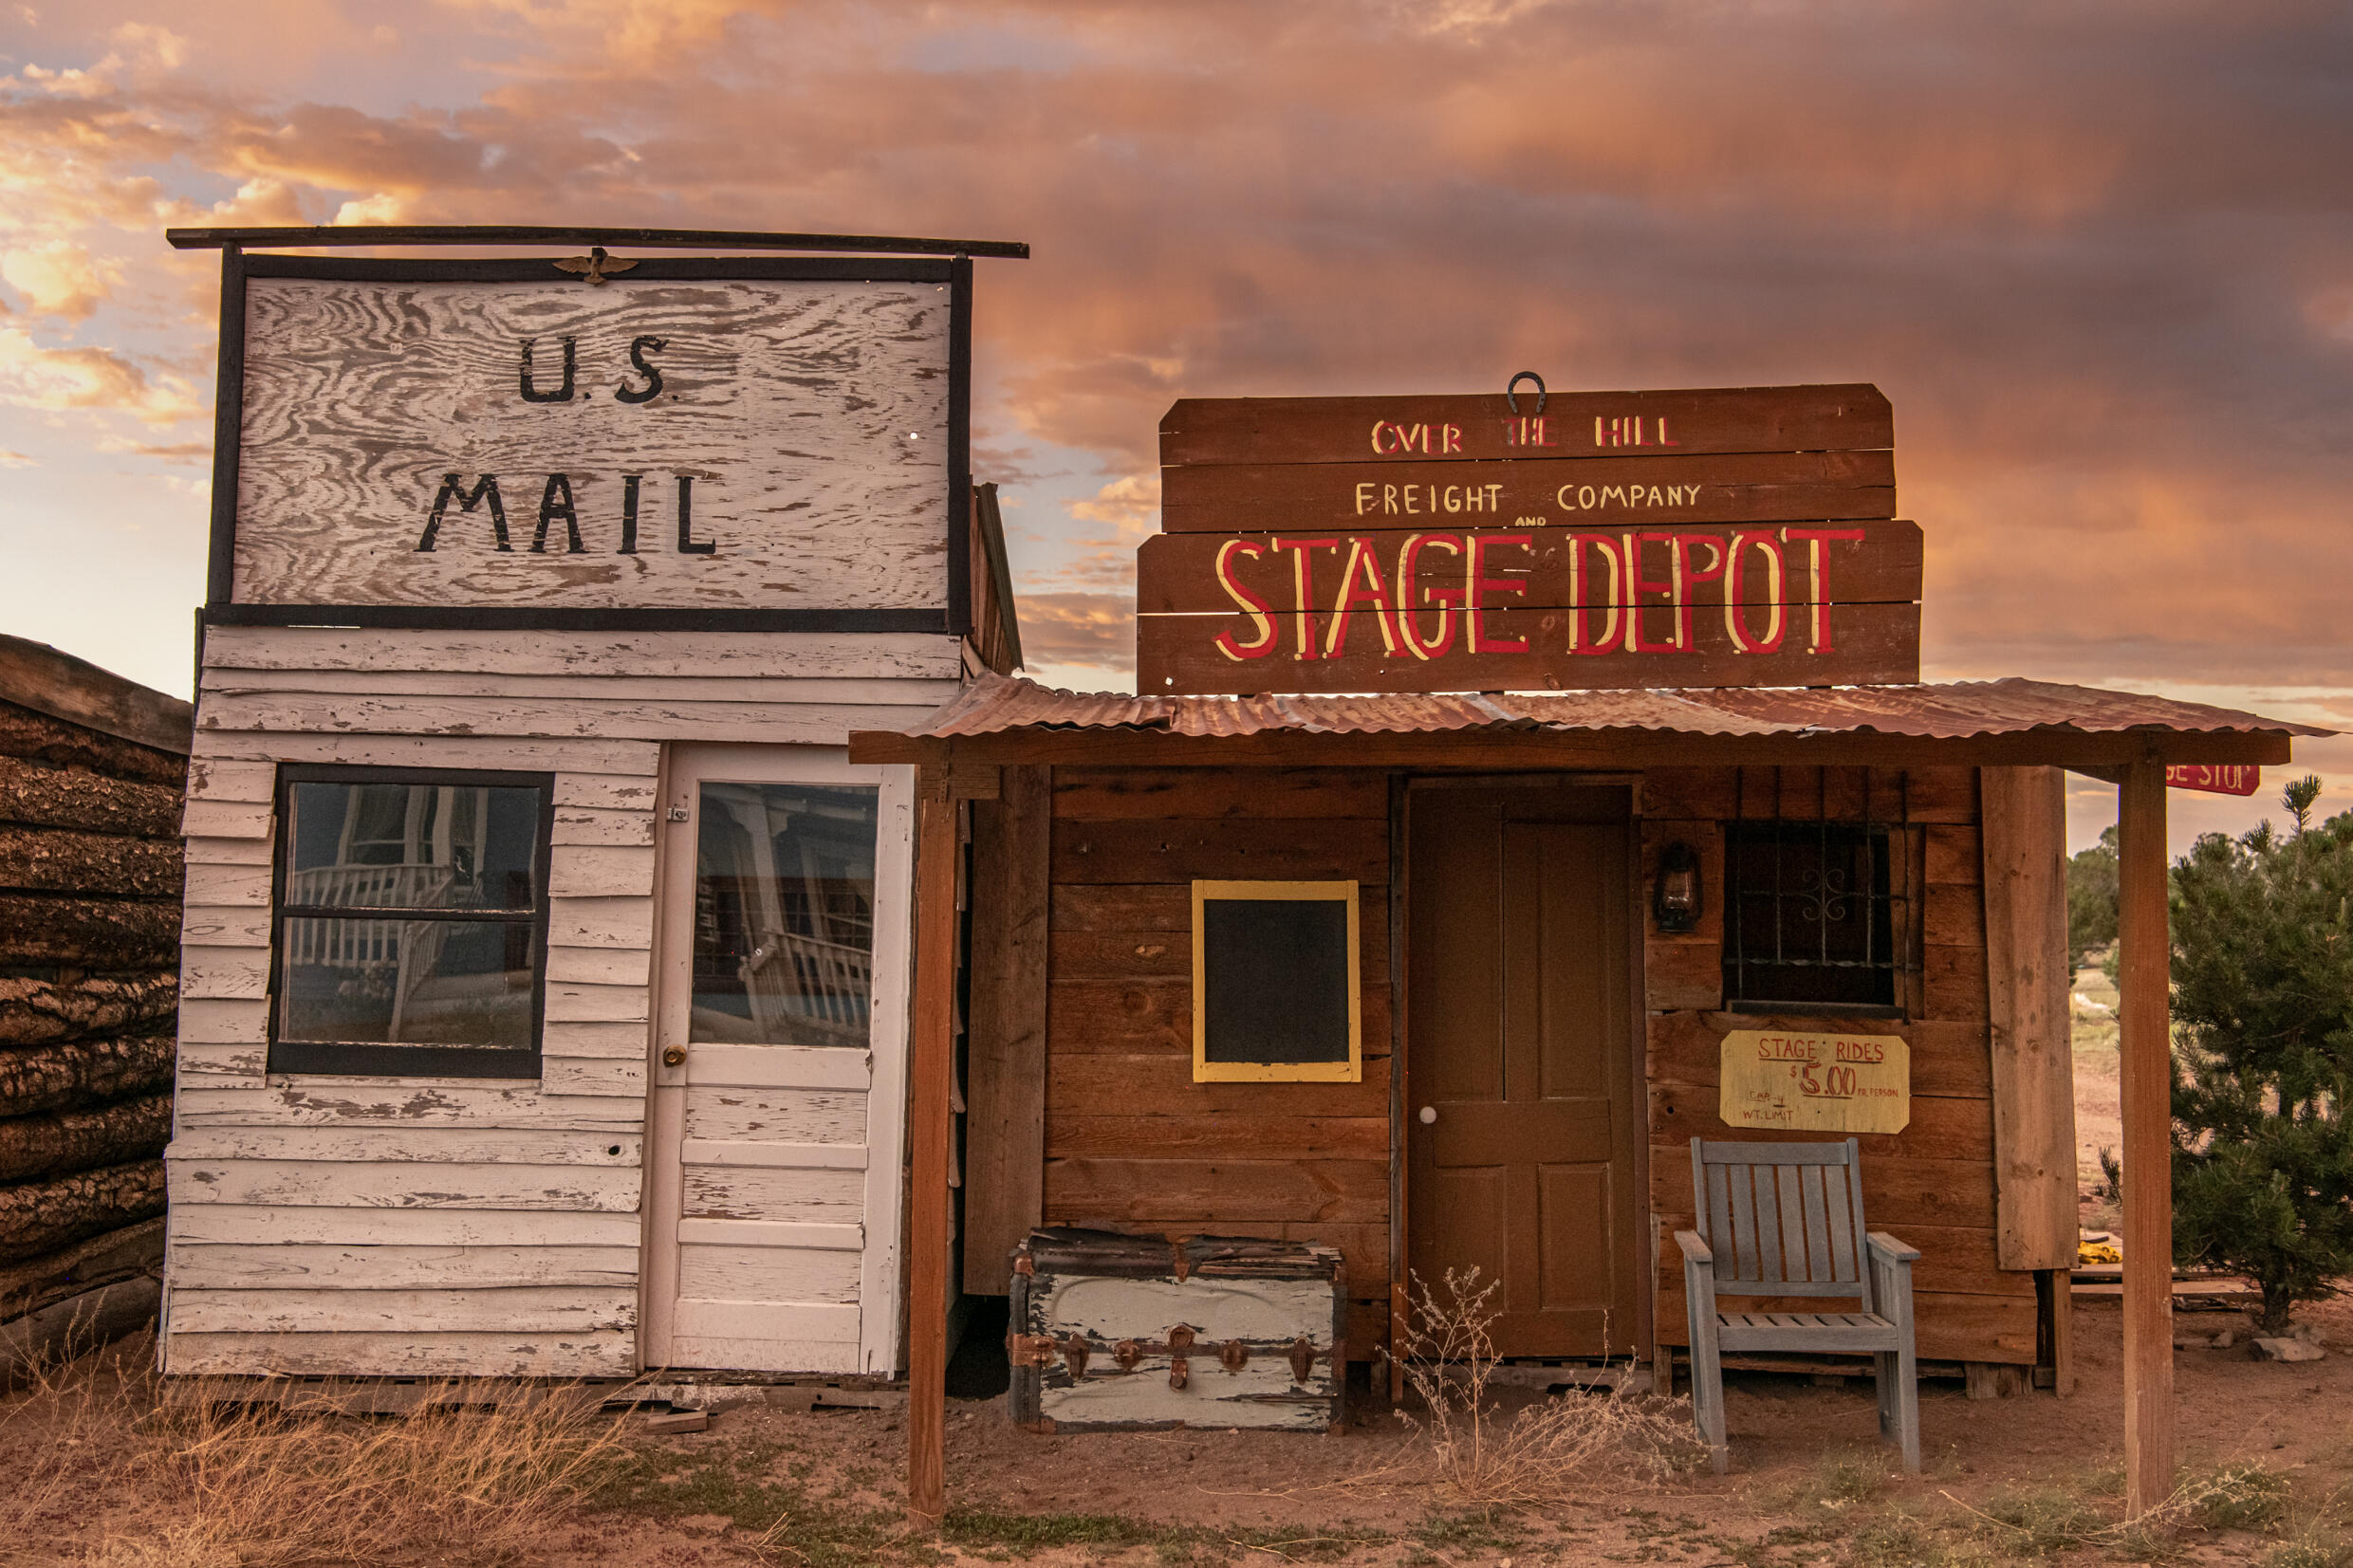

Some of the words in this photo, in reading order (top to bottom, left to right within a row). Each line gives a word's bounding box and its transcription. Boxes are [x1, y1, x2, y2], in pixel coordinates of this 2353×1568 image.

[518, 335, 678, 405] U.S.
[1371, 419, 1463, 454] OVER
[1502, 416, 1558, 447] THE
[1595, 415, 1679, 448] HILL
[413, 472, 717, 555] MAIL
[1356, 483, 1504, 515] FREIGHT
[1557, 484, 1701, 511] COMPANY
[1515, 516, 1547, 527] AND
[1213, 532, 1536, 662] STAGE
[1566, 525, 1866, 658] DEPOT
[1758, 1038, 1818, 1059] STAGE
[1836, 1042, 1884, 1061] RIDES
